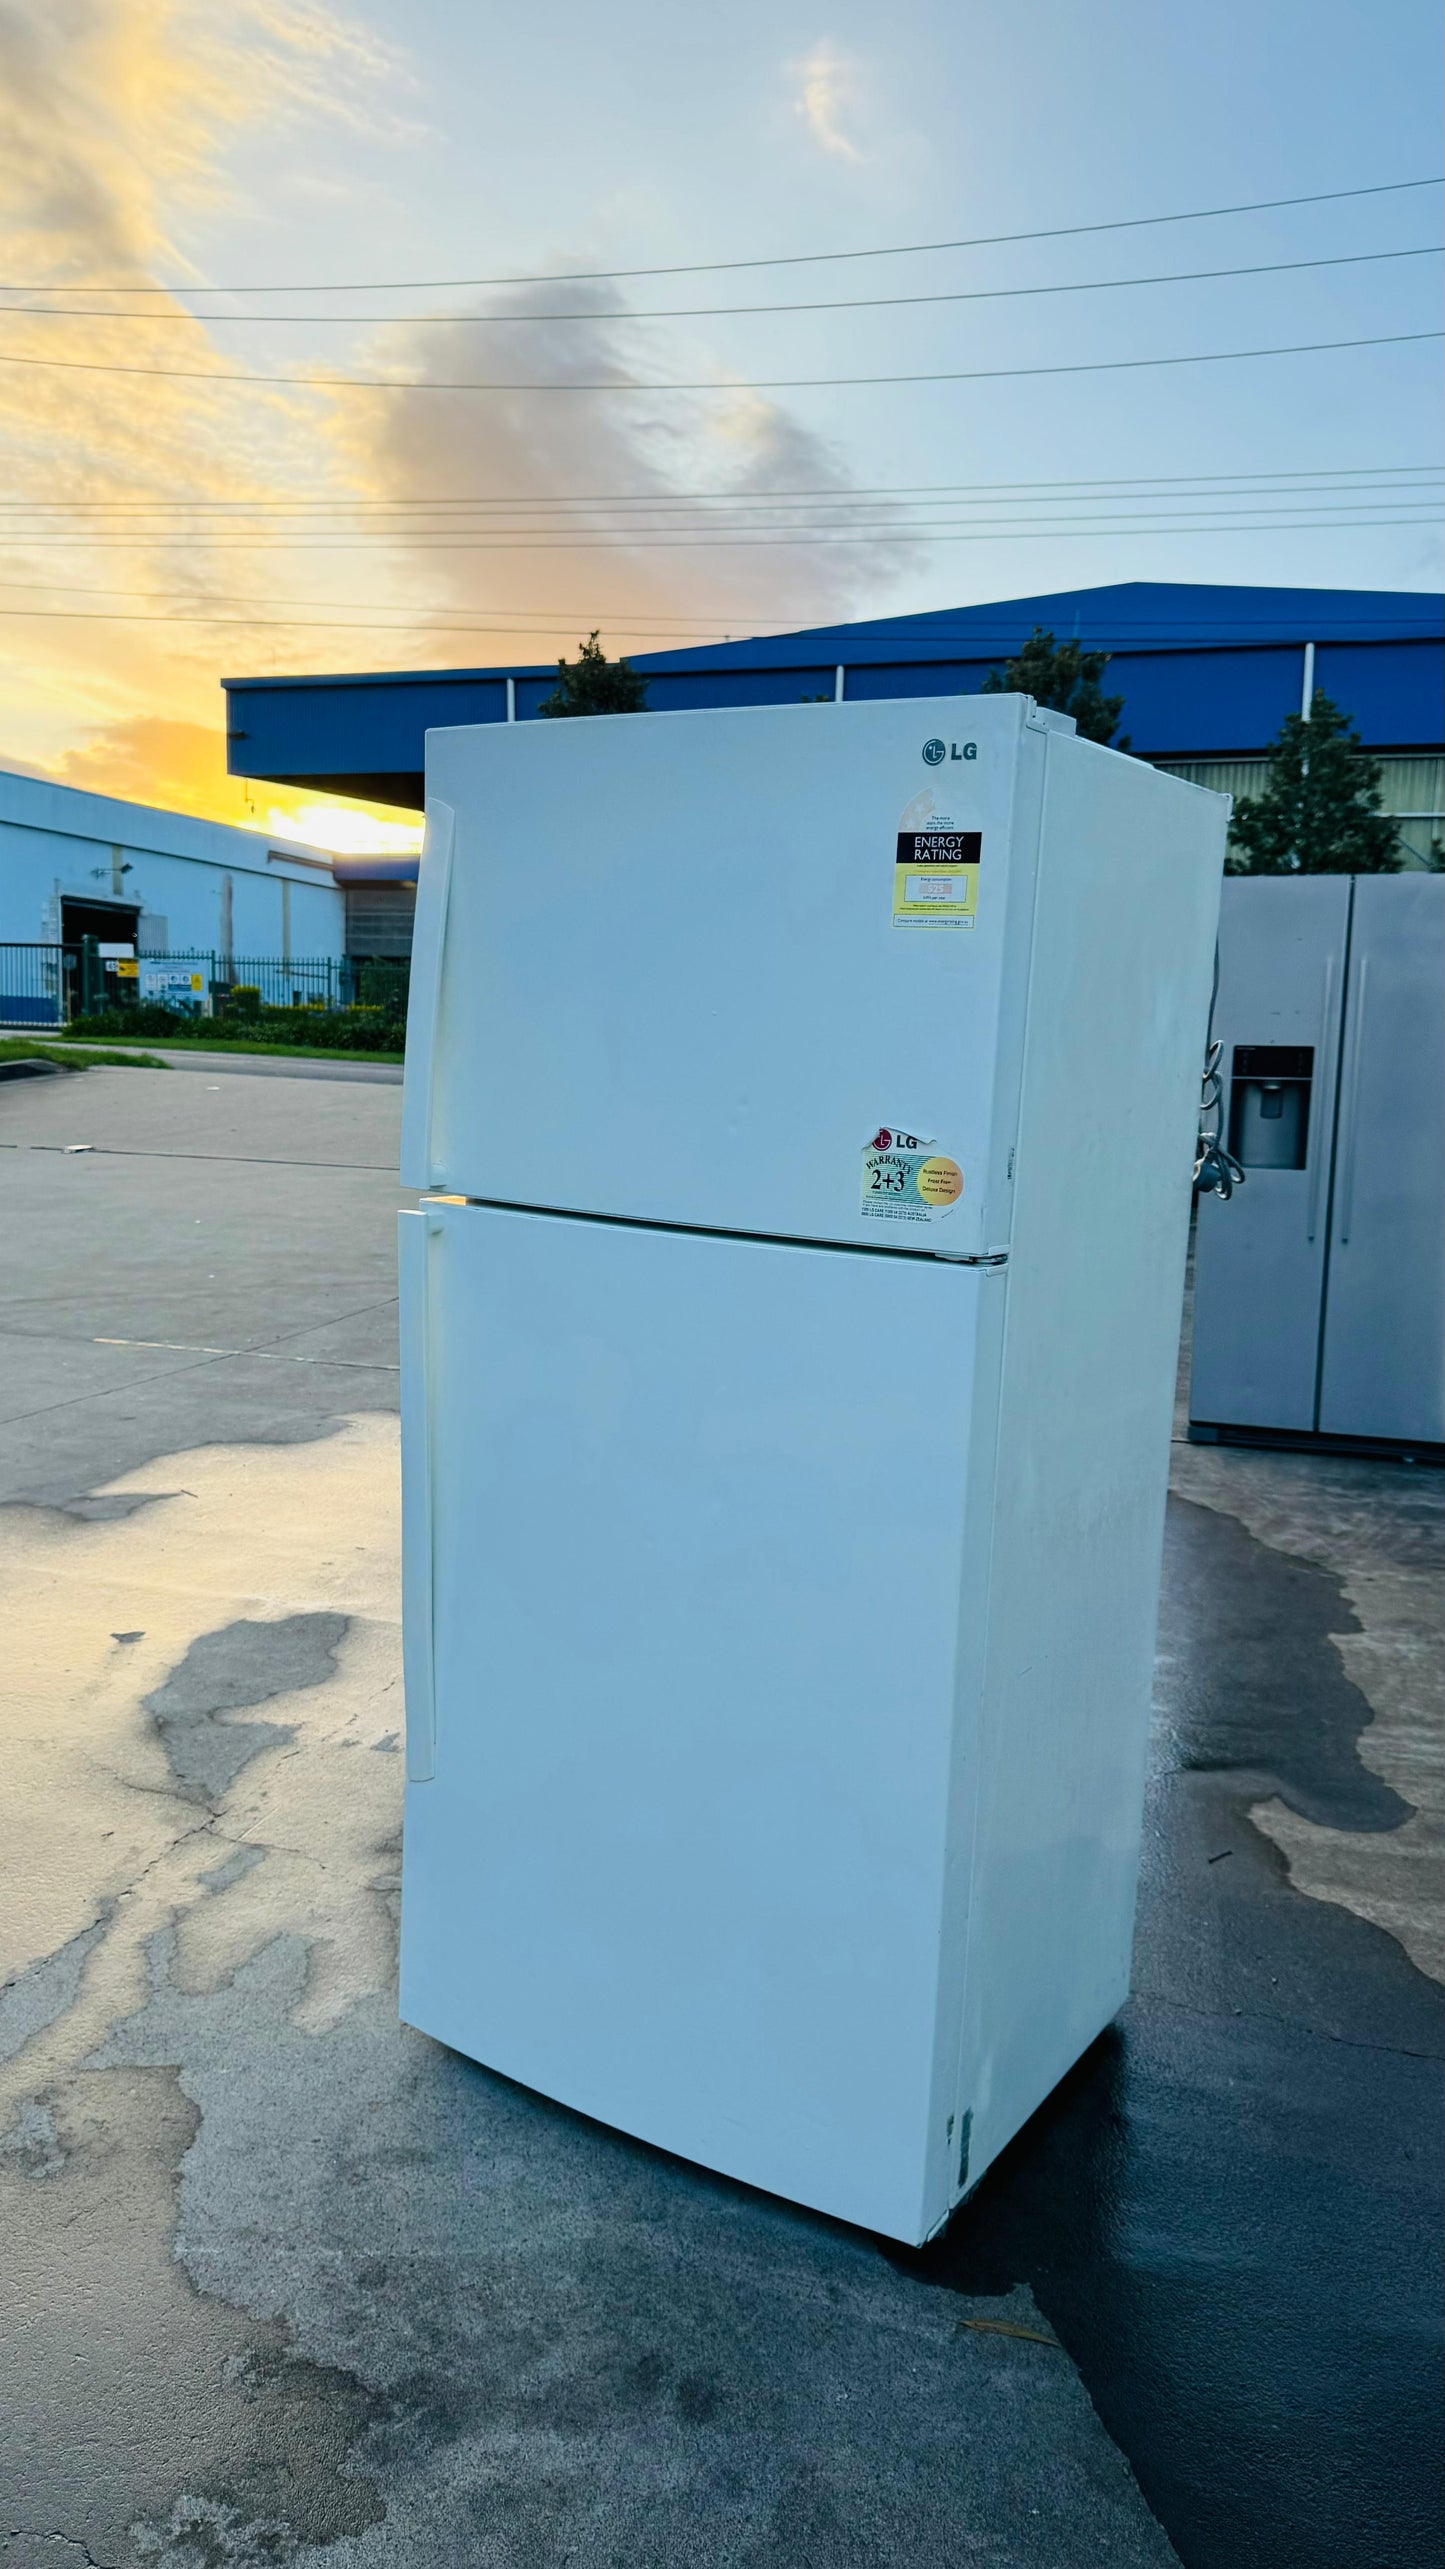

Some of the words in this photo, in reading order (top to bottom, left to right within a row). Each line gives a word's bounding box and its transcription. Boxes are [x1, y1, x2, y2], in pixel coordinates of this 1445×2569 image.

[950, 742, 977, 760] LG
[914, 836, 964, 848] ENERGY
[914, 849, 962, 861] RATING
[896, 1135, 917, 1149] LG
[866, 1155, 914, 1174] WARRANTY
[870, 1169, 905, 1192] 2+3
